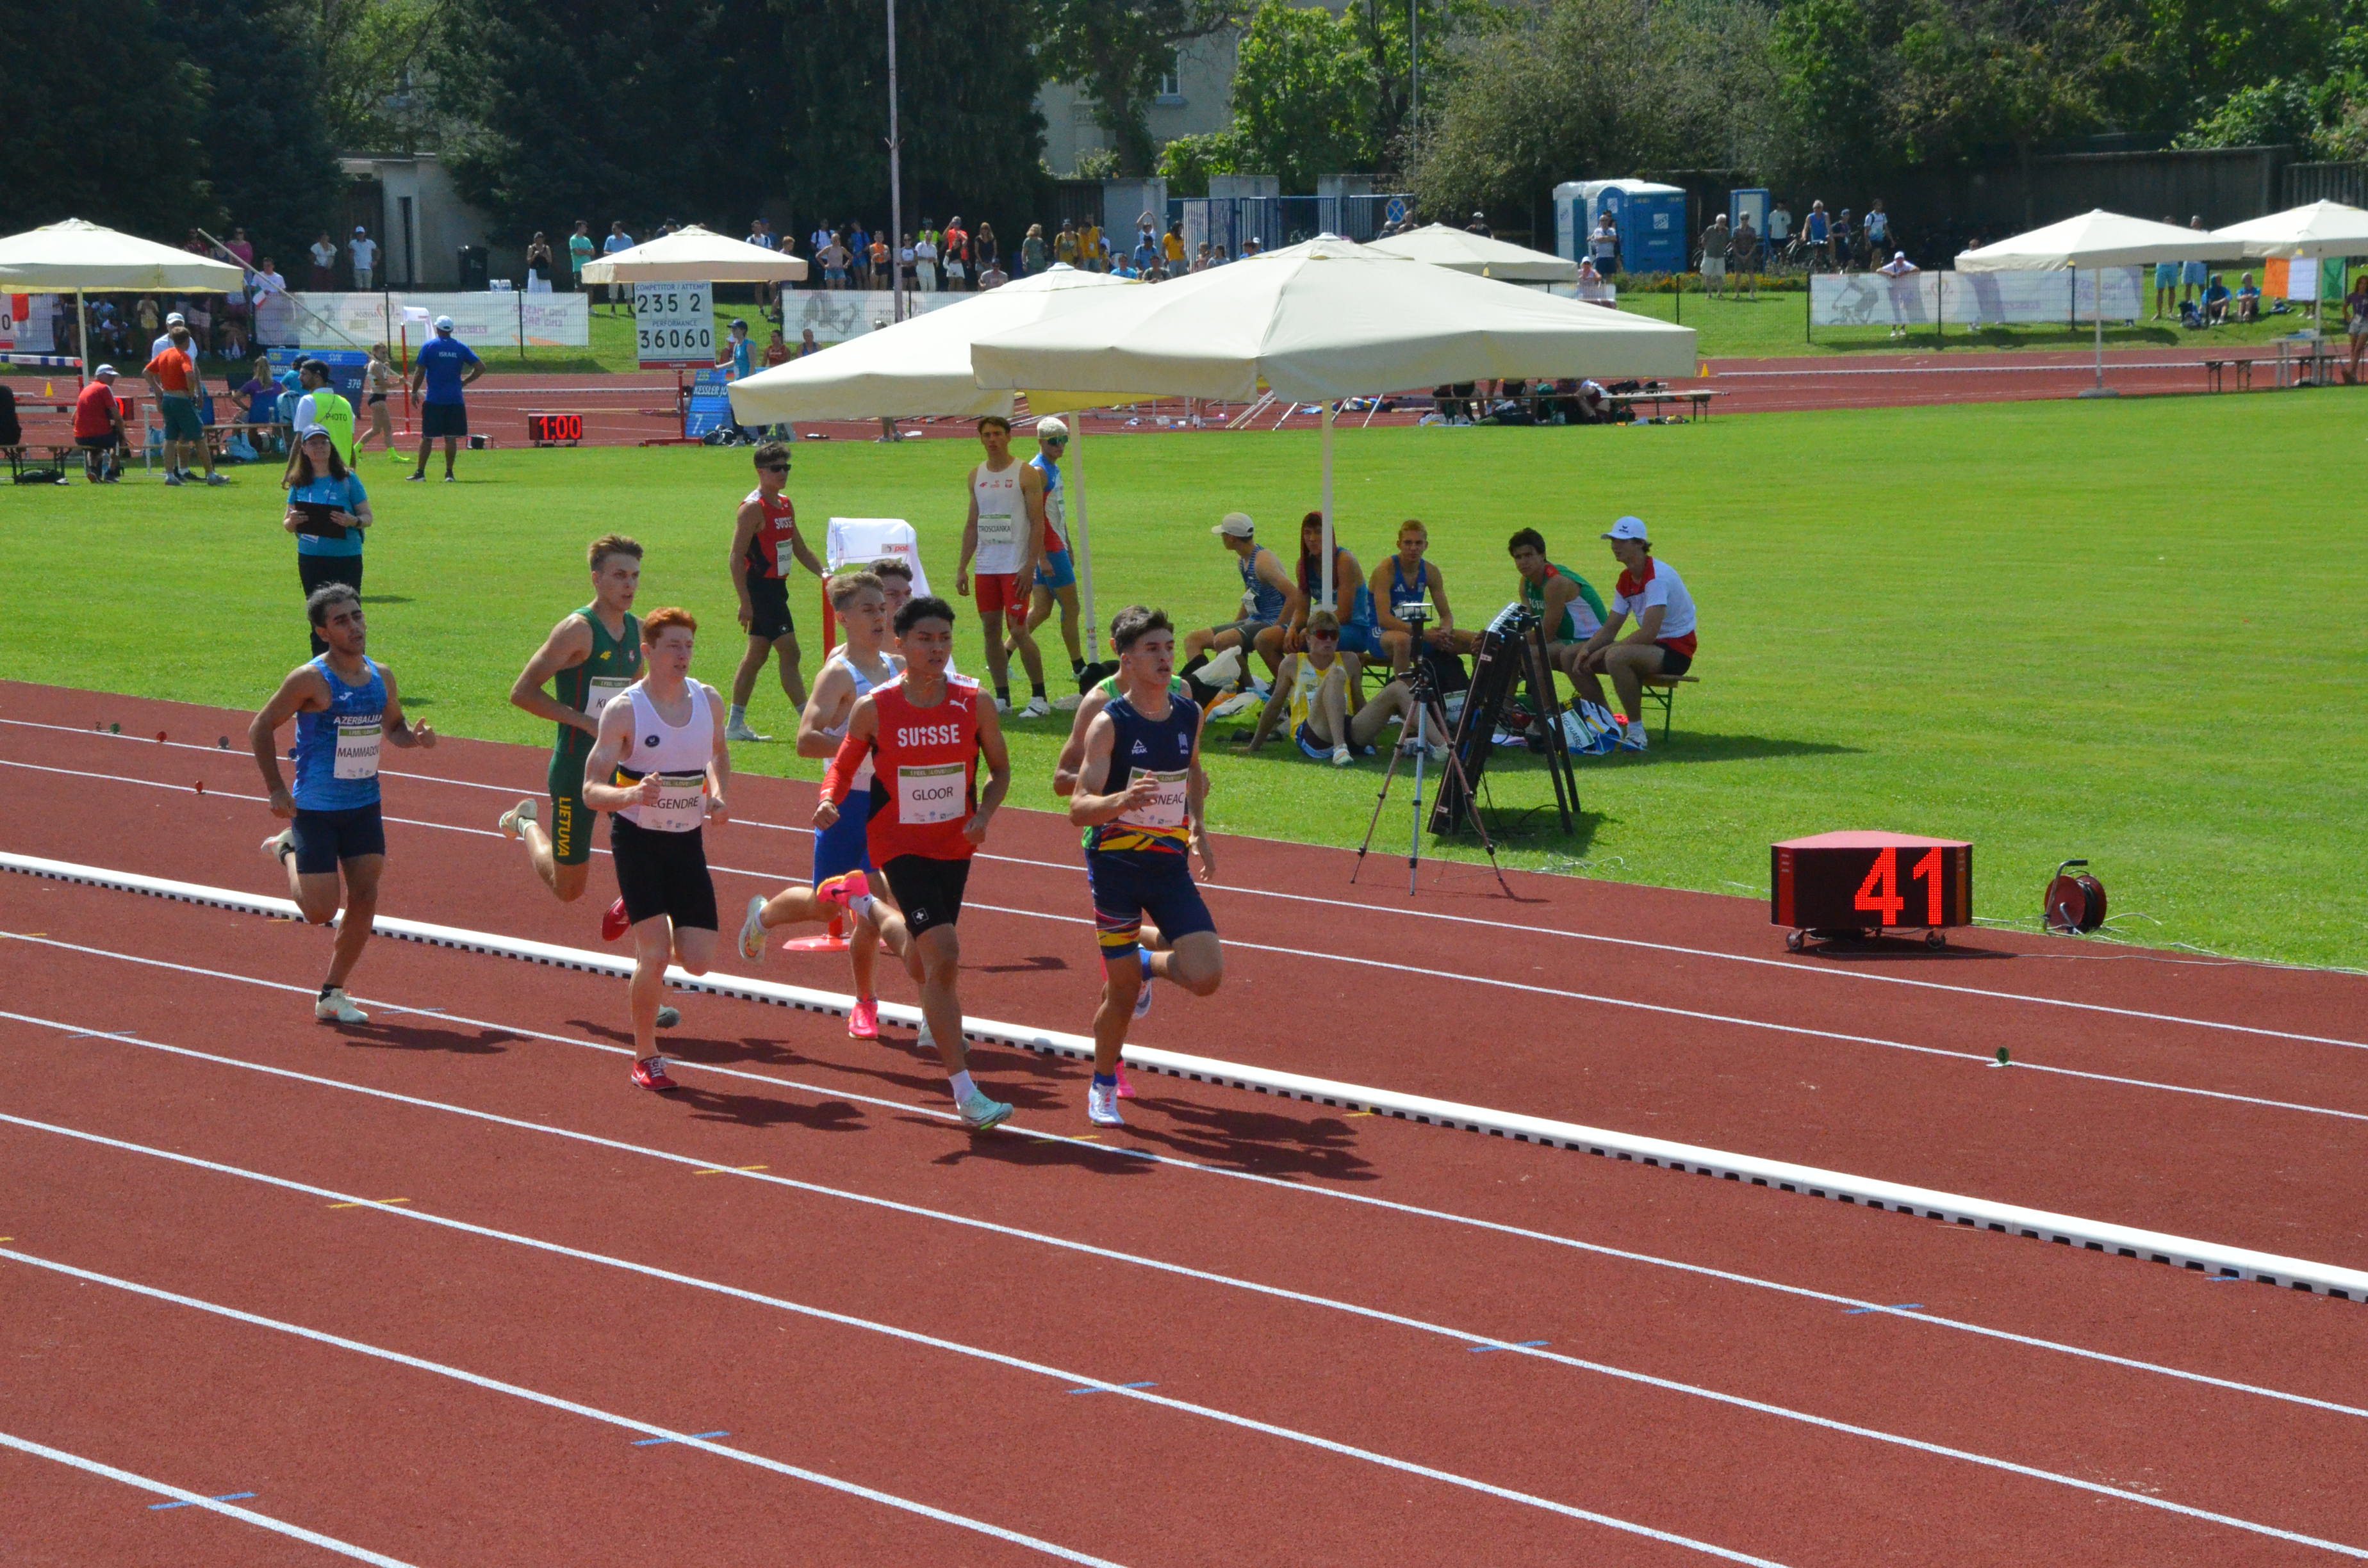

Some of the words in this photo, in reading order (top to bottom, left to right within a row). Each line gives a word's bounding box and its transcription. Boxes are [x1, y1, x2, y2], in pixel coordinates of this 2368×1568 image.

[689, 293, 701, 312] 2
[347, 379, 361, 389] 370
[693, 386, 719, 395] KESSLER
[325, 412, 347, 421] PHOTO
[539, 415, 581, 440] 1:00
[912, 787, 953, 801] GLOOR
[557, 797, 571, 856] LIETUVA
[1855, 846, 1942, 925] 41
